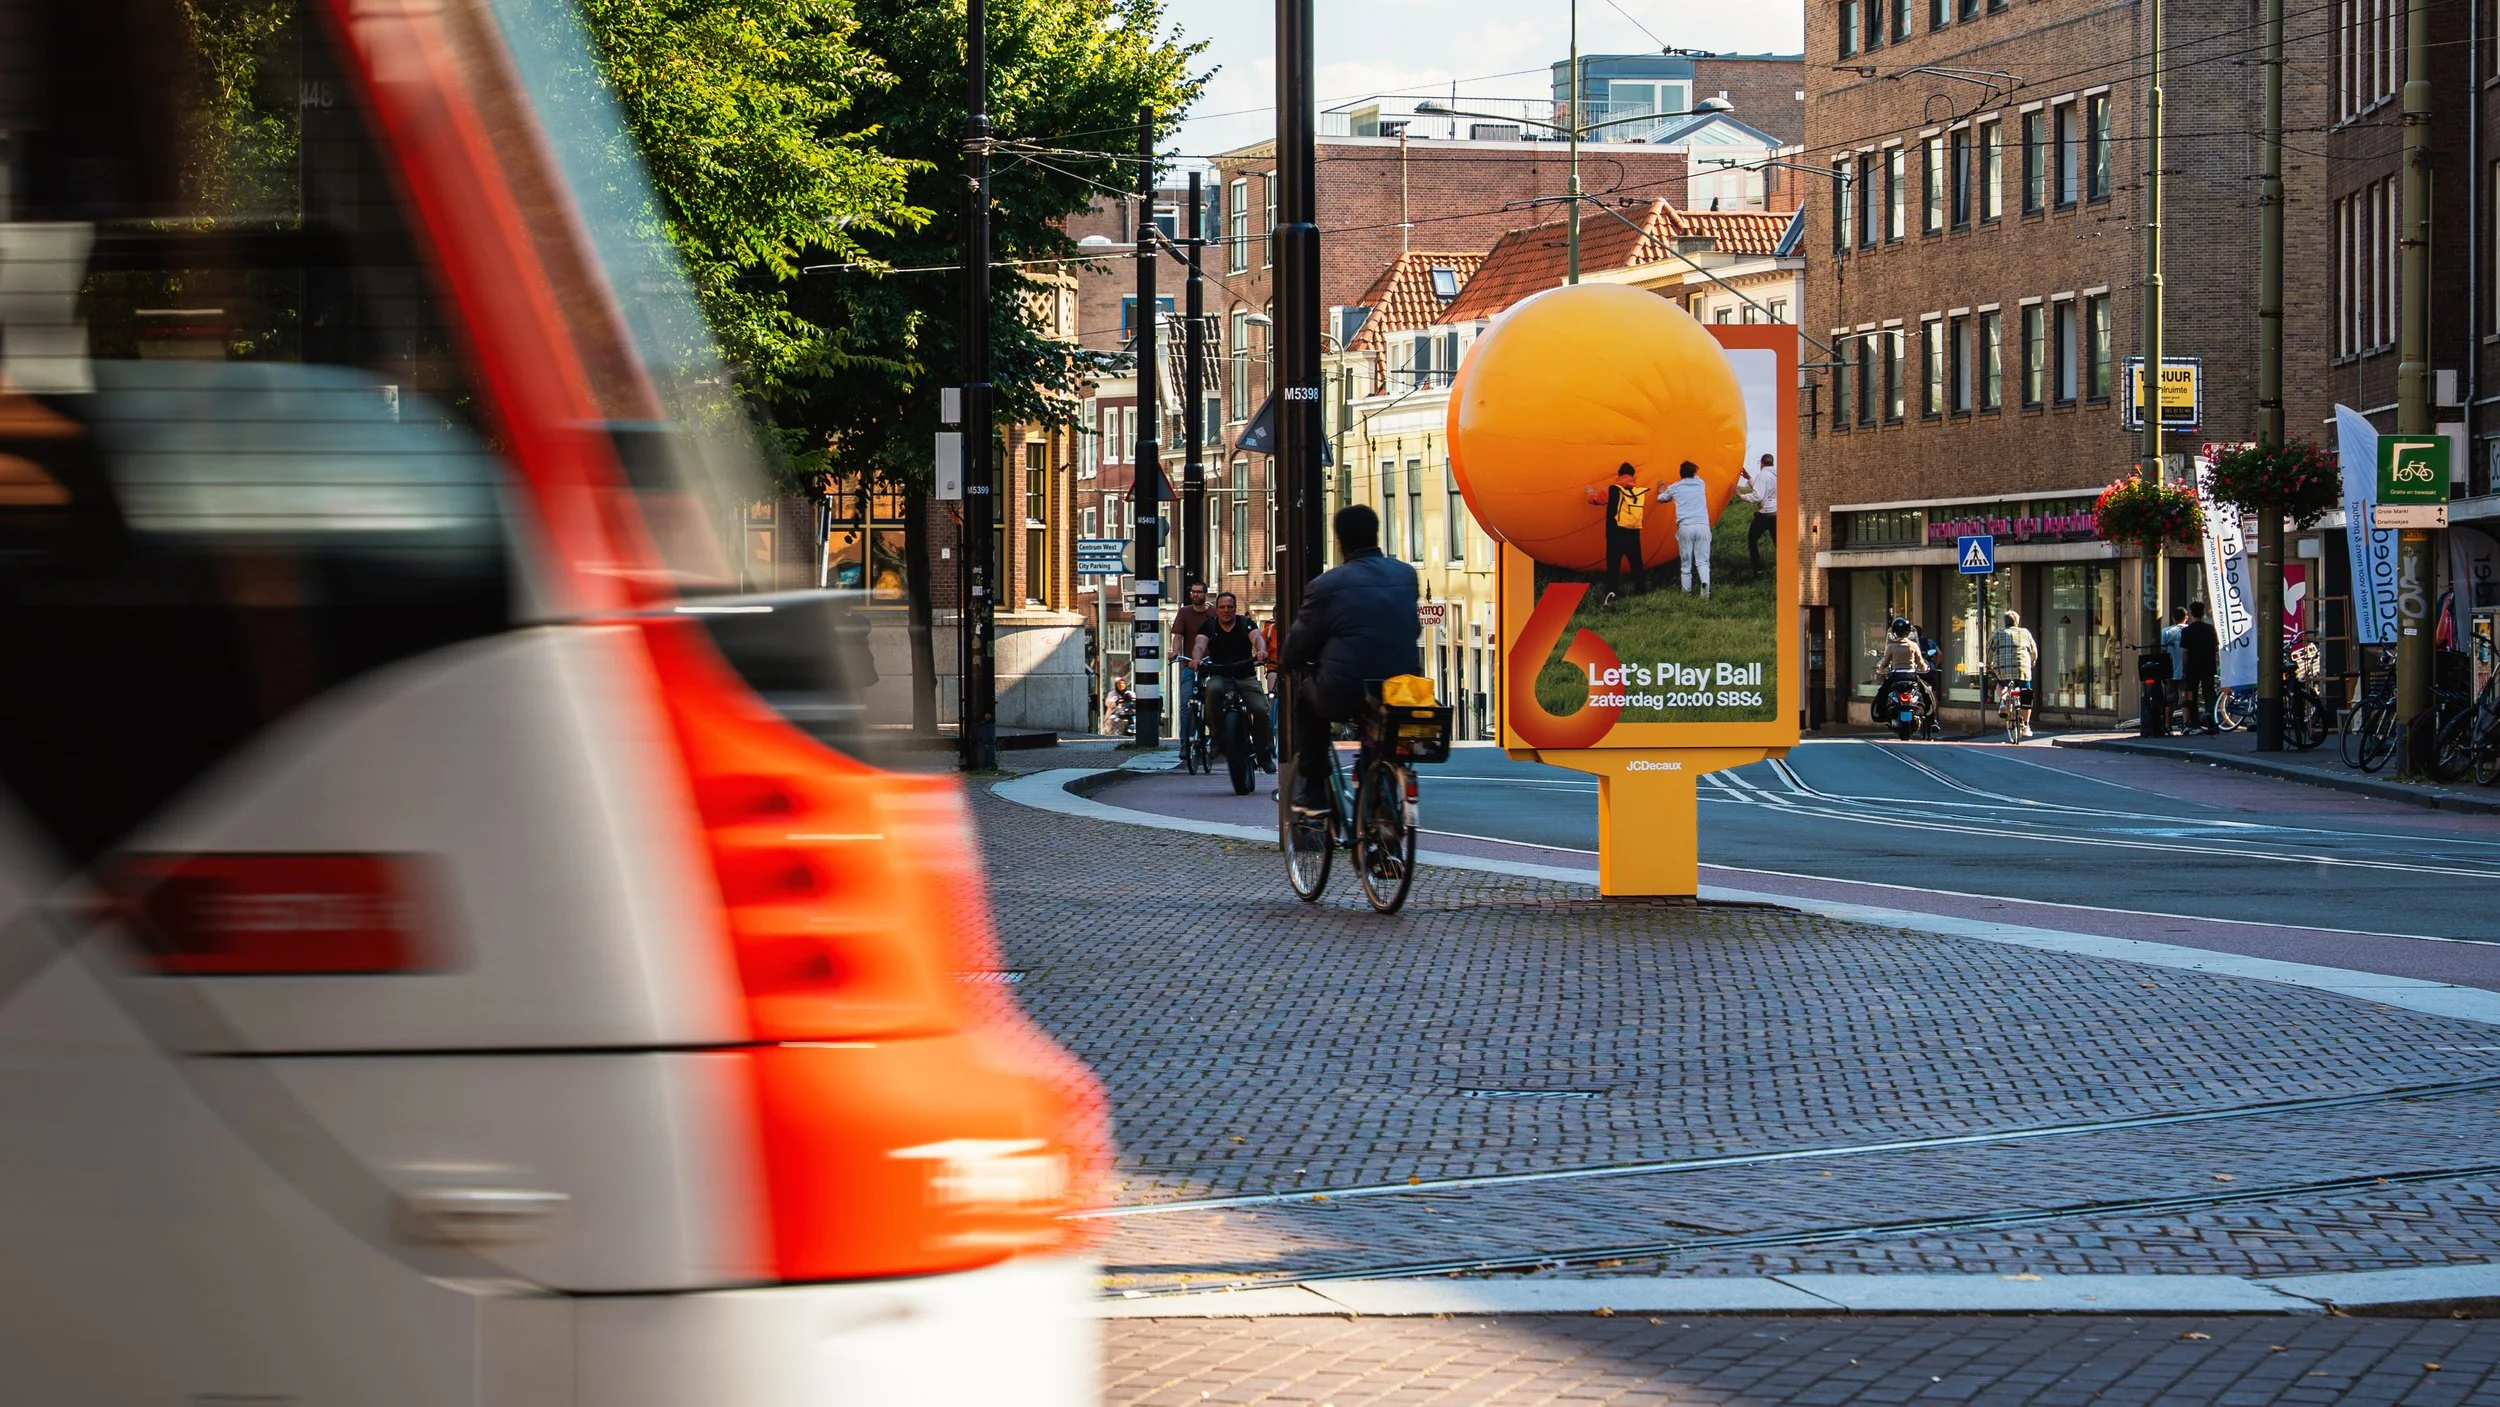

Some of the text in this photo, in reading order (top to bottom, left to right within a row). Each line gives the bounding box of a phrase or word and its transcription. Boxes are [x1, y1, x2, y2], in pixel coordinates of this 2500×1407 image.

[1284, 387, 1319, 402] M5398
[967, 485, 990, 495] M5399
[1137, 516, 1156, 524] M5400
[1986, 514, 2012, 536] kent
[2013, 517, 2041, 543] geen
[1078, 562, 1111, 570] City Parking
[1420, 617, 1442, 625] TUDIO
[1588, 662, 1762, 692] Let's Play Ball
[1588, 691, 1763, 711] zaterdag 20:00 SBS6
[1626, 760, 1682, 772] JCDecaux
